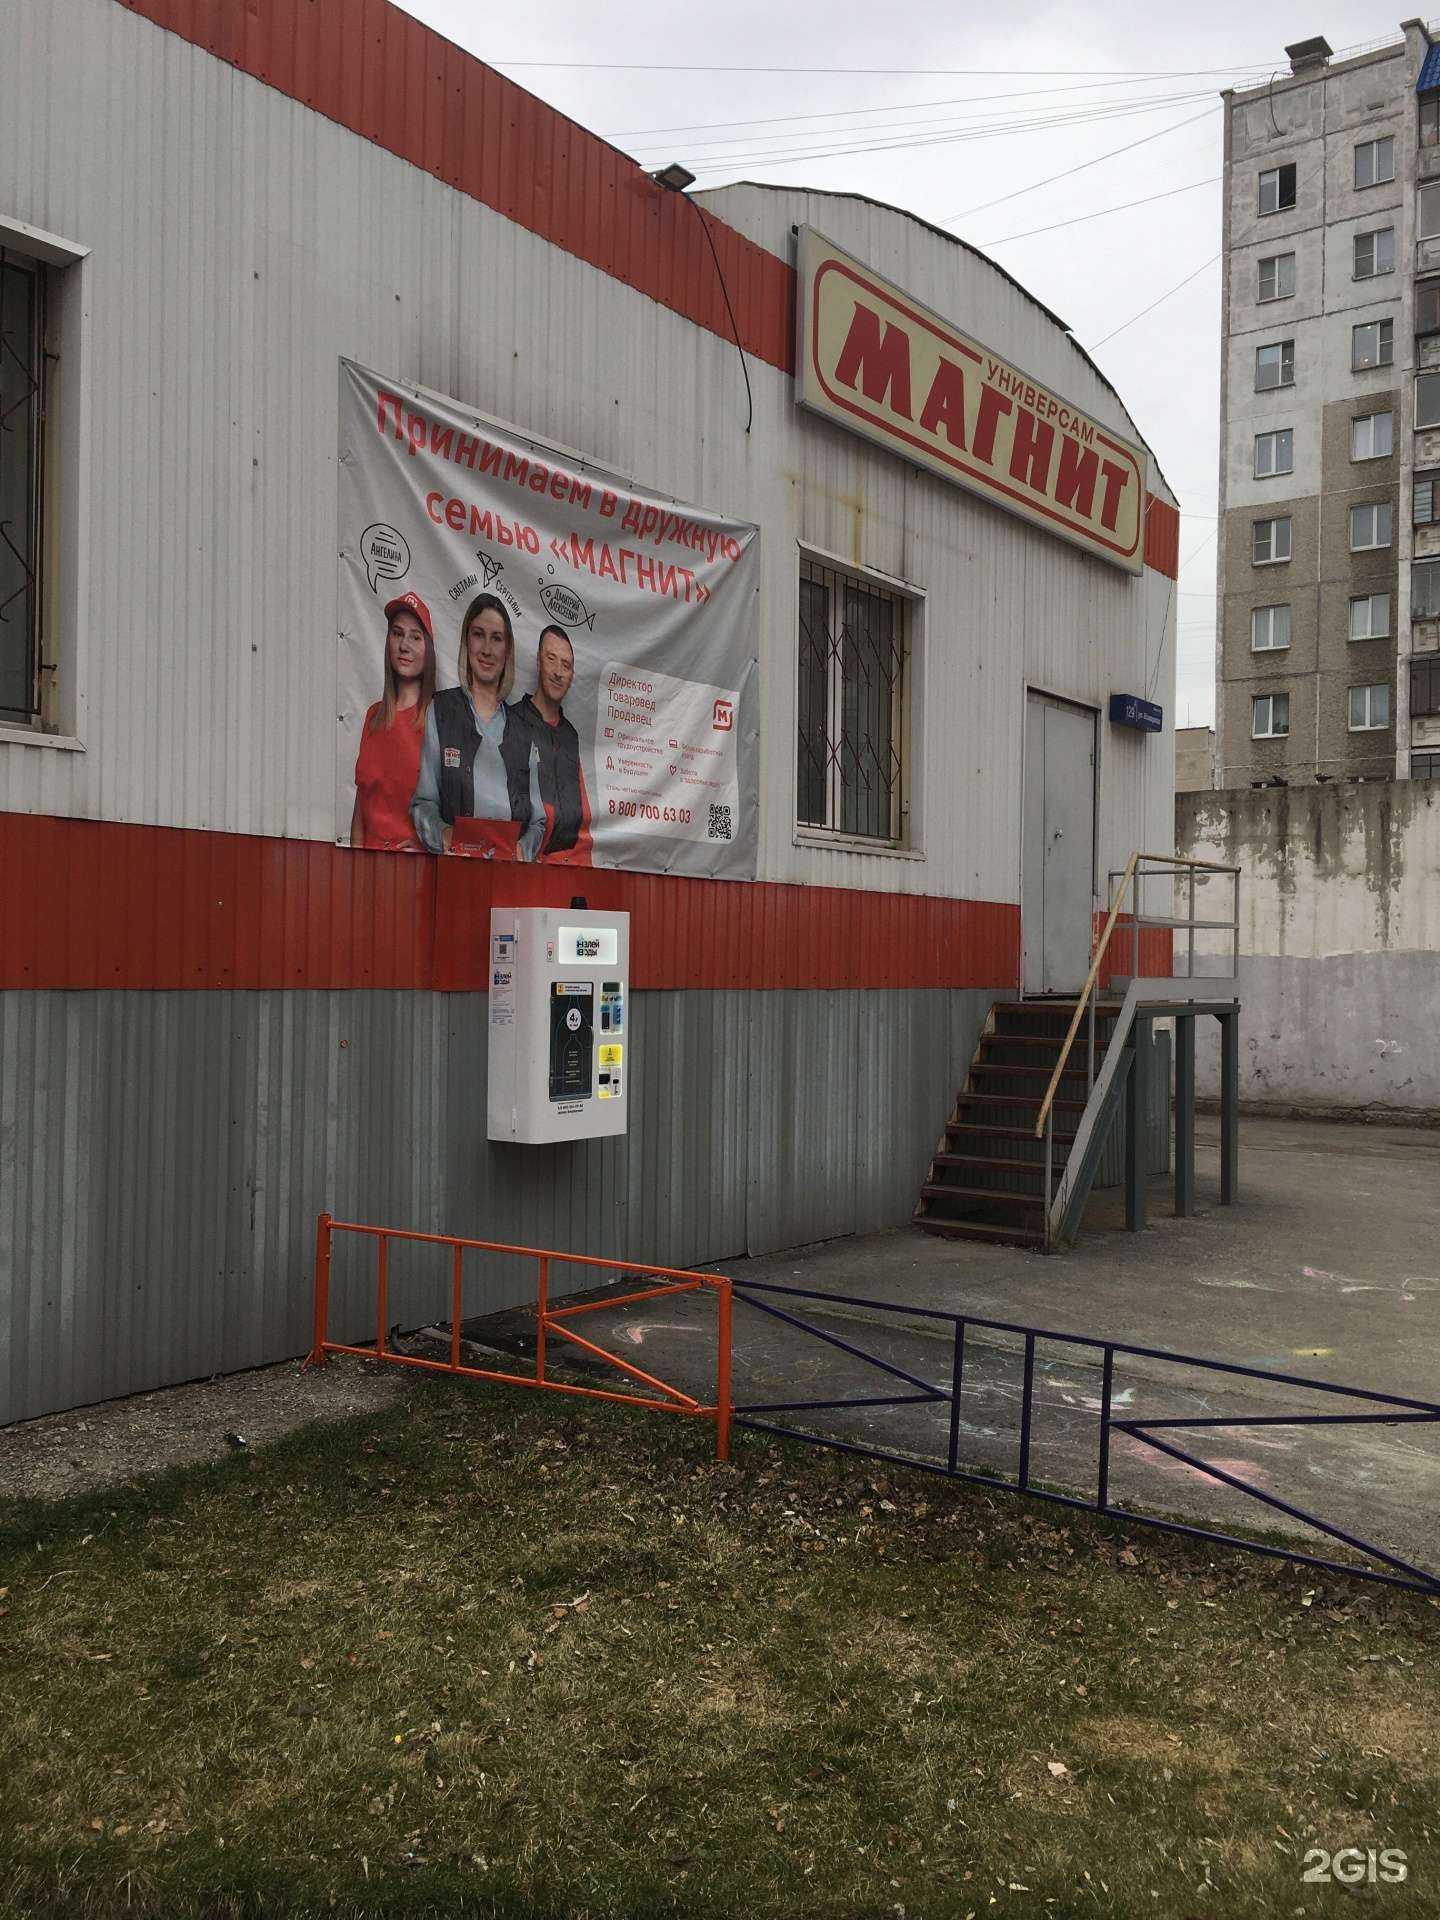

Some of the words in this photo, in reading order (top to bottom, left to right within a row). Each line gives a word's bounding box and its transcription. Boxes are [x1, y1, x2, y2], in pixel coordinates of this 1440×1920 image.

[834, 300, 1130, 533] МАГНИТ
[987, 359, 1095, 445] УНИВЕРСАМ
[377, 390, 592, 510] Принимаем
[600, 489, 615, 518] в
[621, 500, 742, 562] дружную
[425, 491, 540, 555] семью
[550, 532, 712, 605] «МАГНИТ»
[608, 688, 656, 712] Товаровед
[609, 672, 653, 693] Директор
[608, 705, 653, 727] Продавец
[608, 799, 616, 815] 8
[618, 801, 637, 817] 800
[640, 804, 660, 820] 700
[663, 807, 677, 822] 63
[679, 809, 691, 824] 03
